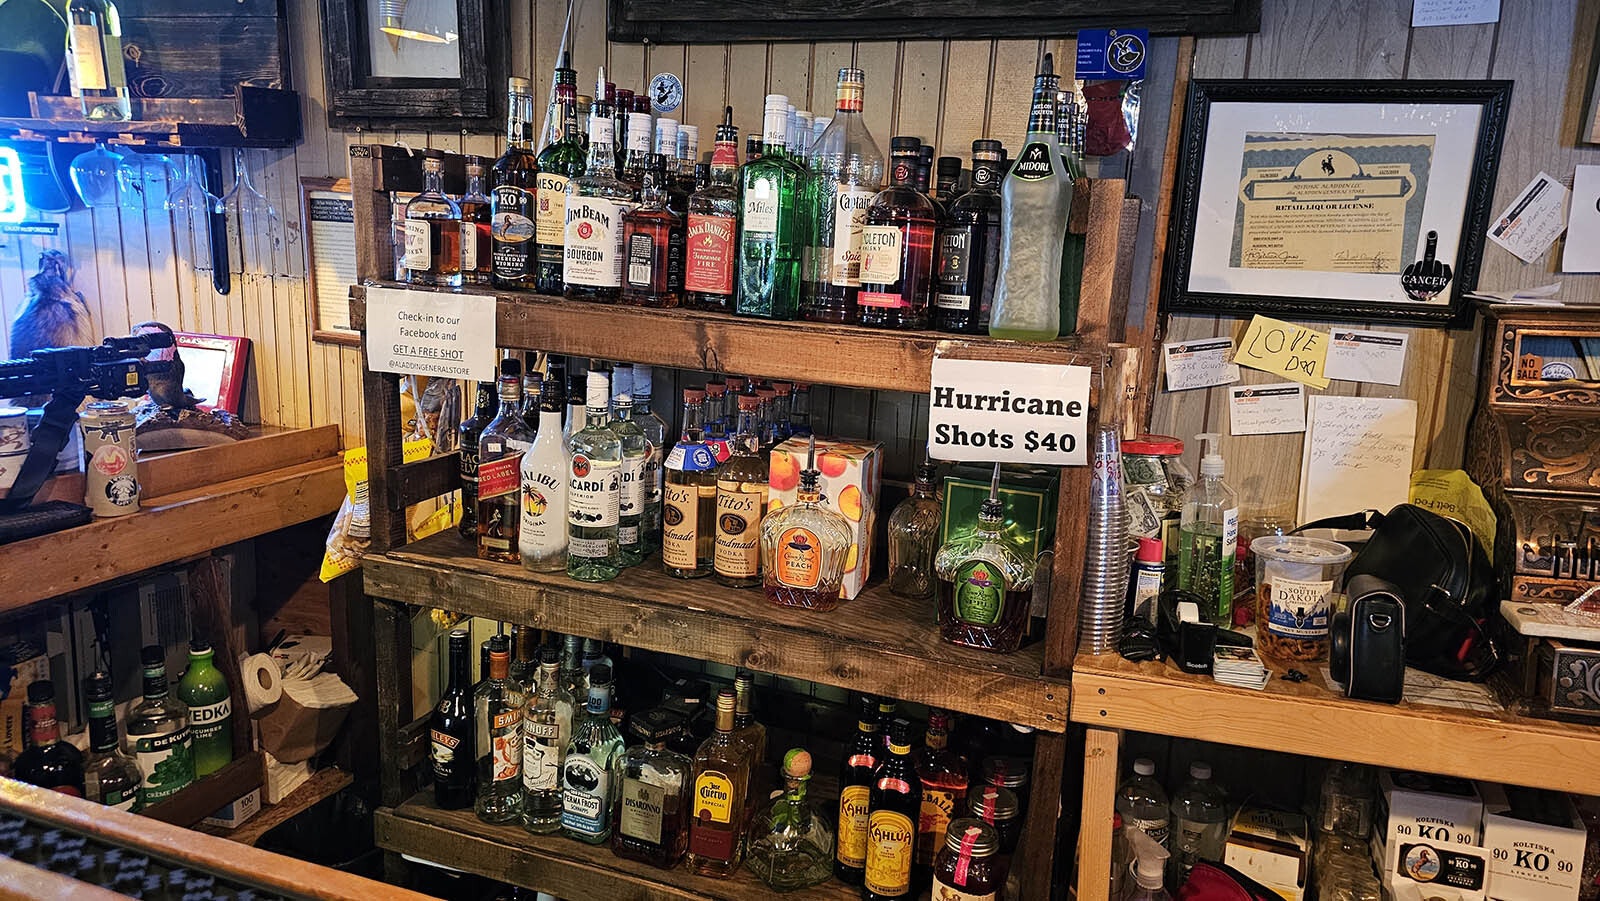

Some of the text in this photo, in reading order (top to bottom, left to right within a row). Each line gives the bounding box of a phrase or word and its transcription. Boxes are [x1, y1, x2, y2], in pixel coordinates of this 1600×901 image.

[1017, 161, 1050, 172] MIDORI
[500, 194, 516, 206] KO
[747, 200, 773, 214] Miles
[566, 204, 610, 230] JIM BEAM
[687, 221, 732, 242] JACK DANIEL'S
[567, 249, 604, 262] BOURBON
[697, 260, 717, 268] FIRE
[1402, 274, 1448, 287] CANCER
[397, 311, 460, 325] Check-in to our
[399, 327, 457, 341] Facebook and
[1247, 325, 1320, 359] LOVE
[393, 344, 464, 360] GET A FREE SHOT
[388, 360, 470, 375] @ALADDINGENERALSTORE
[1521, 359, 1535, 368] NO
[1518, 370, 1539, 379] SALE
[933, 386, 1083, 418] Hurricane
[935, 423, 1077, 454] Shots $40
[492, 469, 516, 480] LABEL
[1436, 501, 1456, 513] Belt
[785, 560, 813, 570] PEACH
[1279, 590, 1325, 604] DAKOTA
[1288, 588, 1317, 596] SOUTH
[709, 782, 720, 790] Jose
[700, 786, 727, 801] Cuervo
[241, 794, 254, 809] 100
[581, 796, 598, 810] FROST
[625, 797, 660, 815] DISARONNO
[702, 800, 725, 809] ESPECIAL
[1415, 816, 1455, 828] KOLTISKA
[869, 819, 913, 846] KAHLÚA
[1397, 823, 1472, 845] 90 KO 90
[1512, 841, 1556, 855] KOLTISKA
[1455, 859, 1470, 869] KO
[1492, 847, 1573, 873] 90 KO 90
